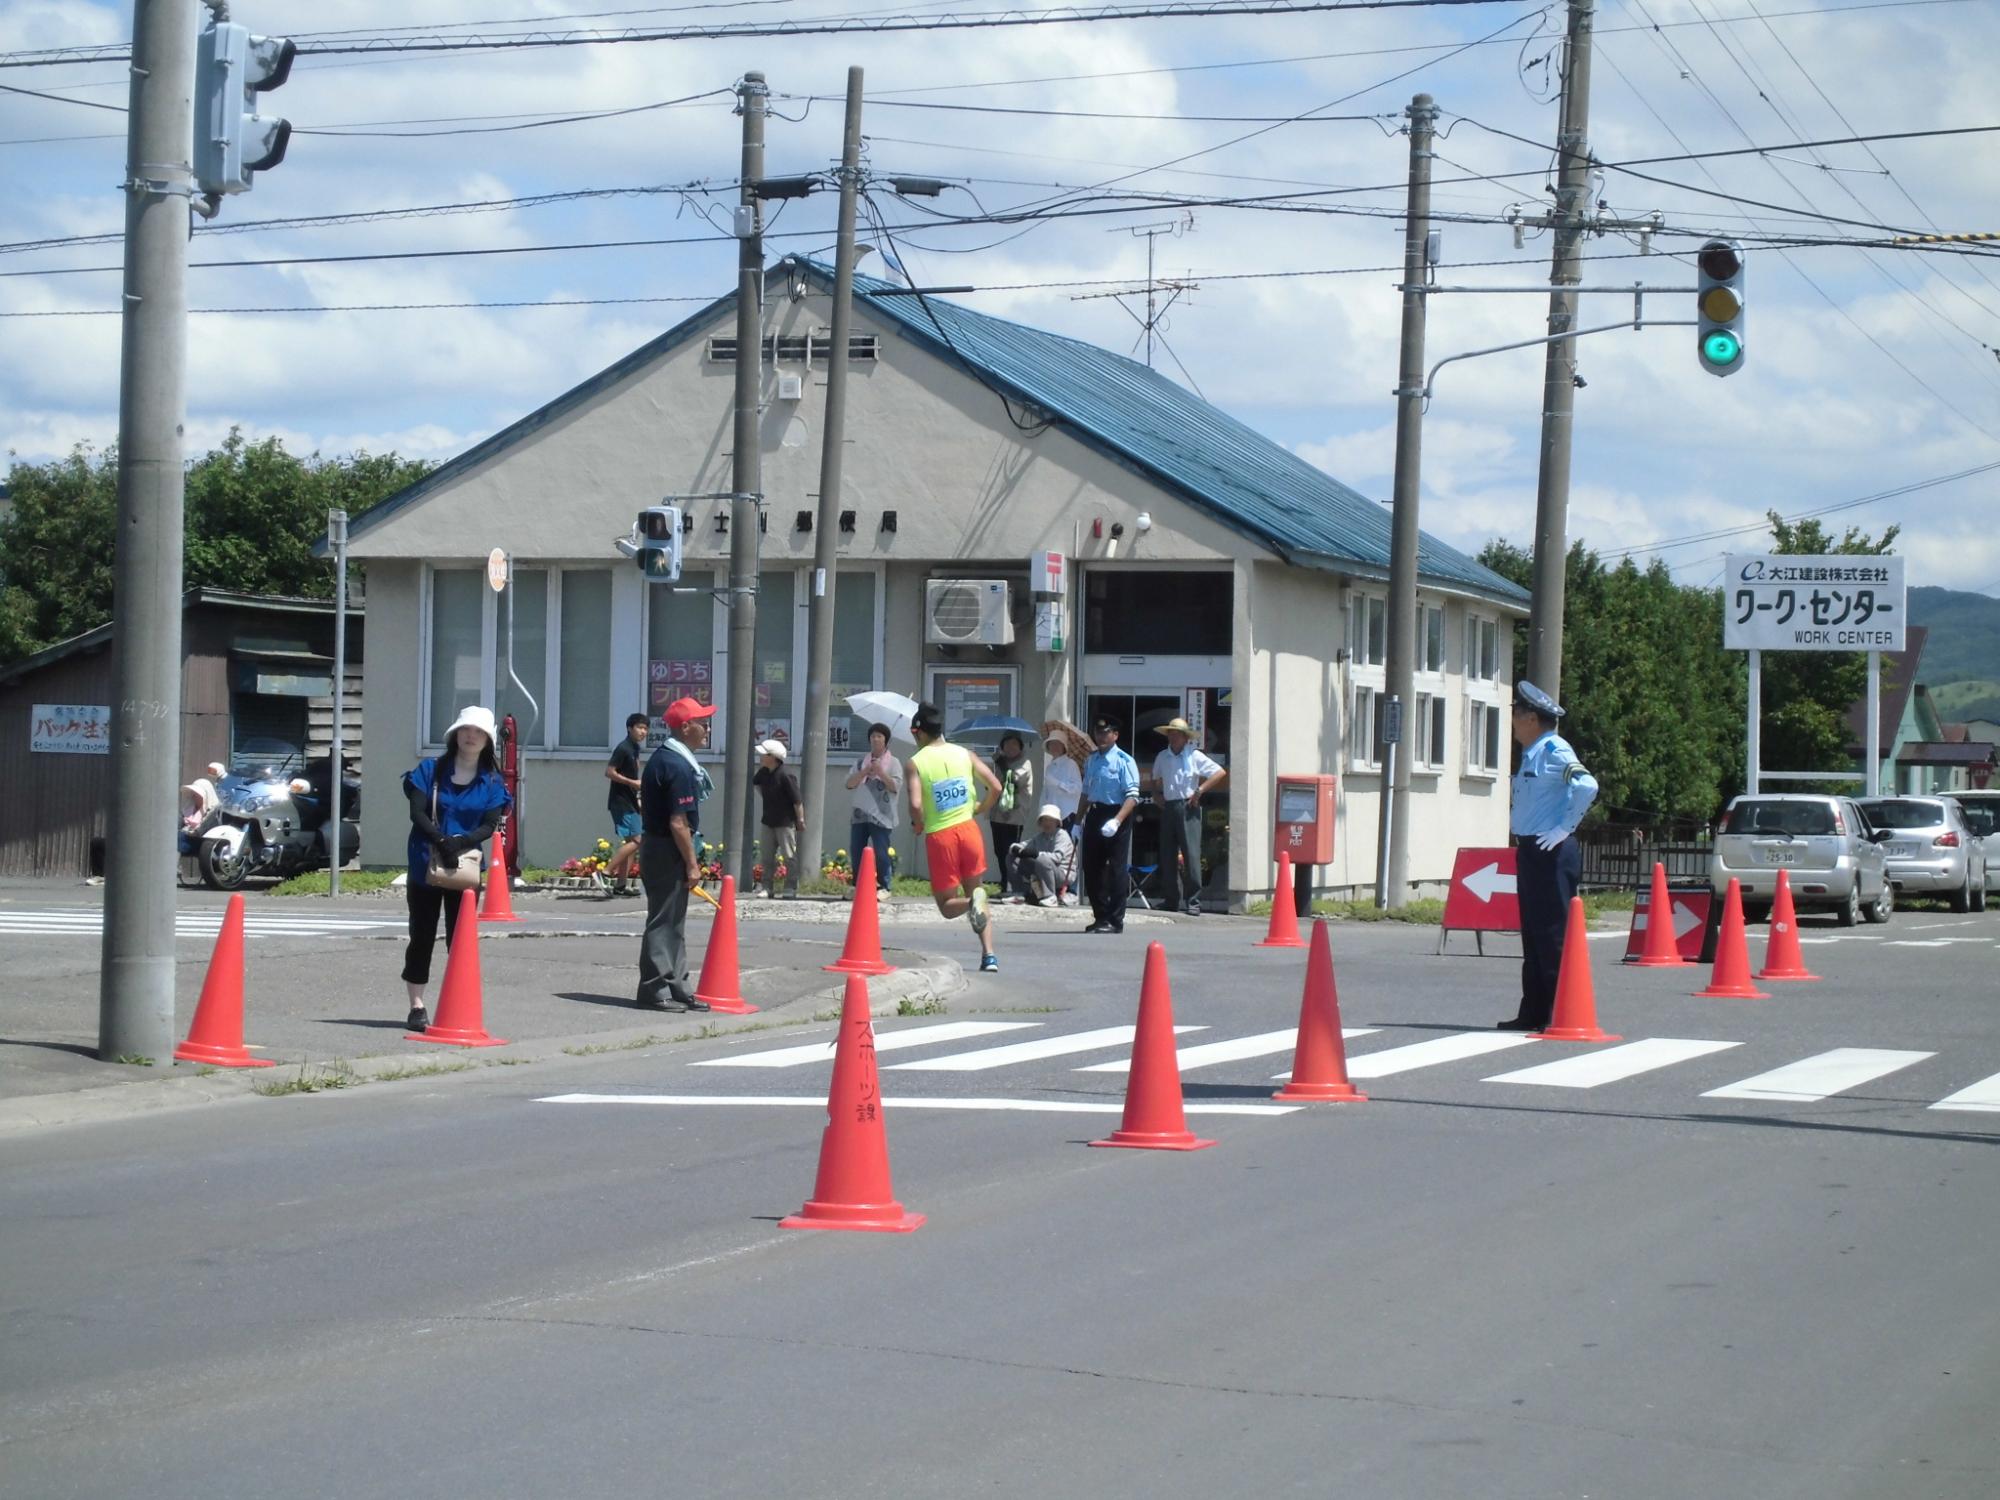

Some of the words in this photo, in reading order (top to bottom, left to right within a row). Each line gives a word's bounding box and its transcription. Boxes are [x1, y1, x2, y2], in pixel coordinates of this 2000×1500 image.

[1769, 567, 1889, 582] 大江建設株式会社
[1736, 589, 1893, 625] ワーク・センター
[1795, 631, 1831, 645] WORK
[1838, 631, 1893, 645] CENTER
